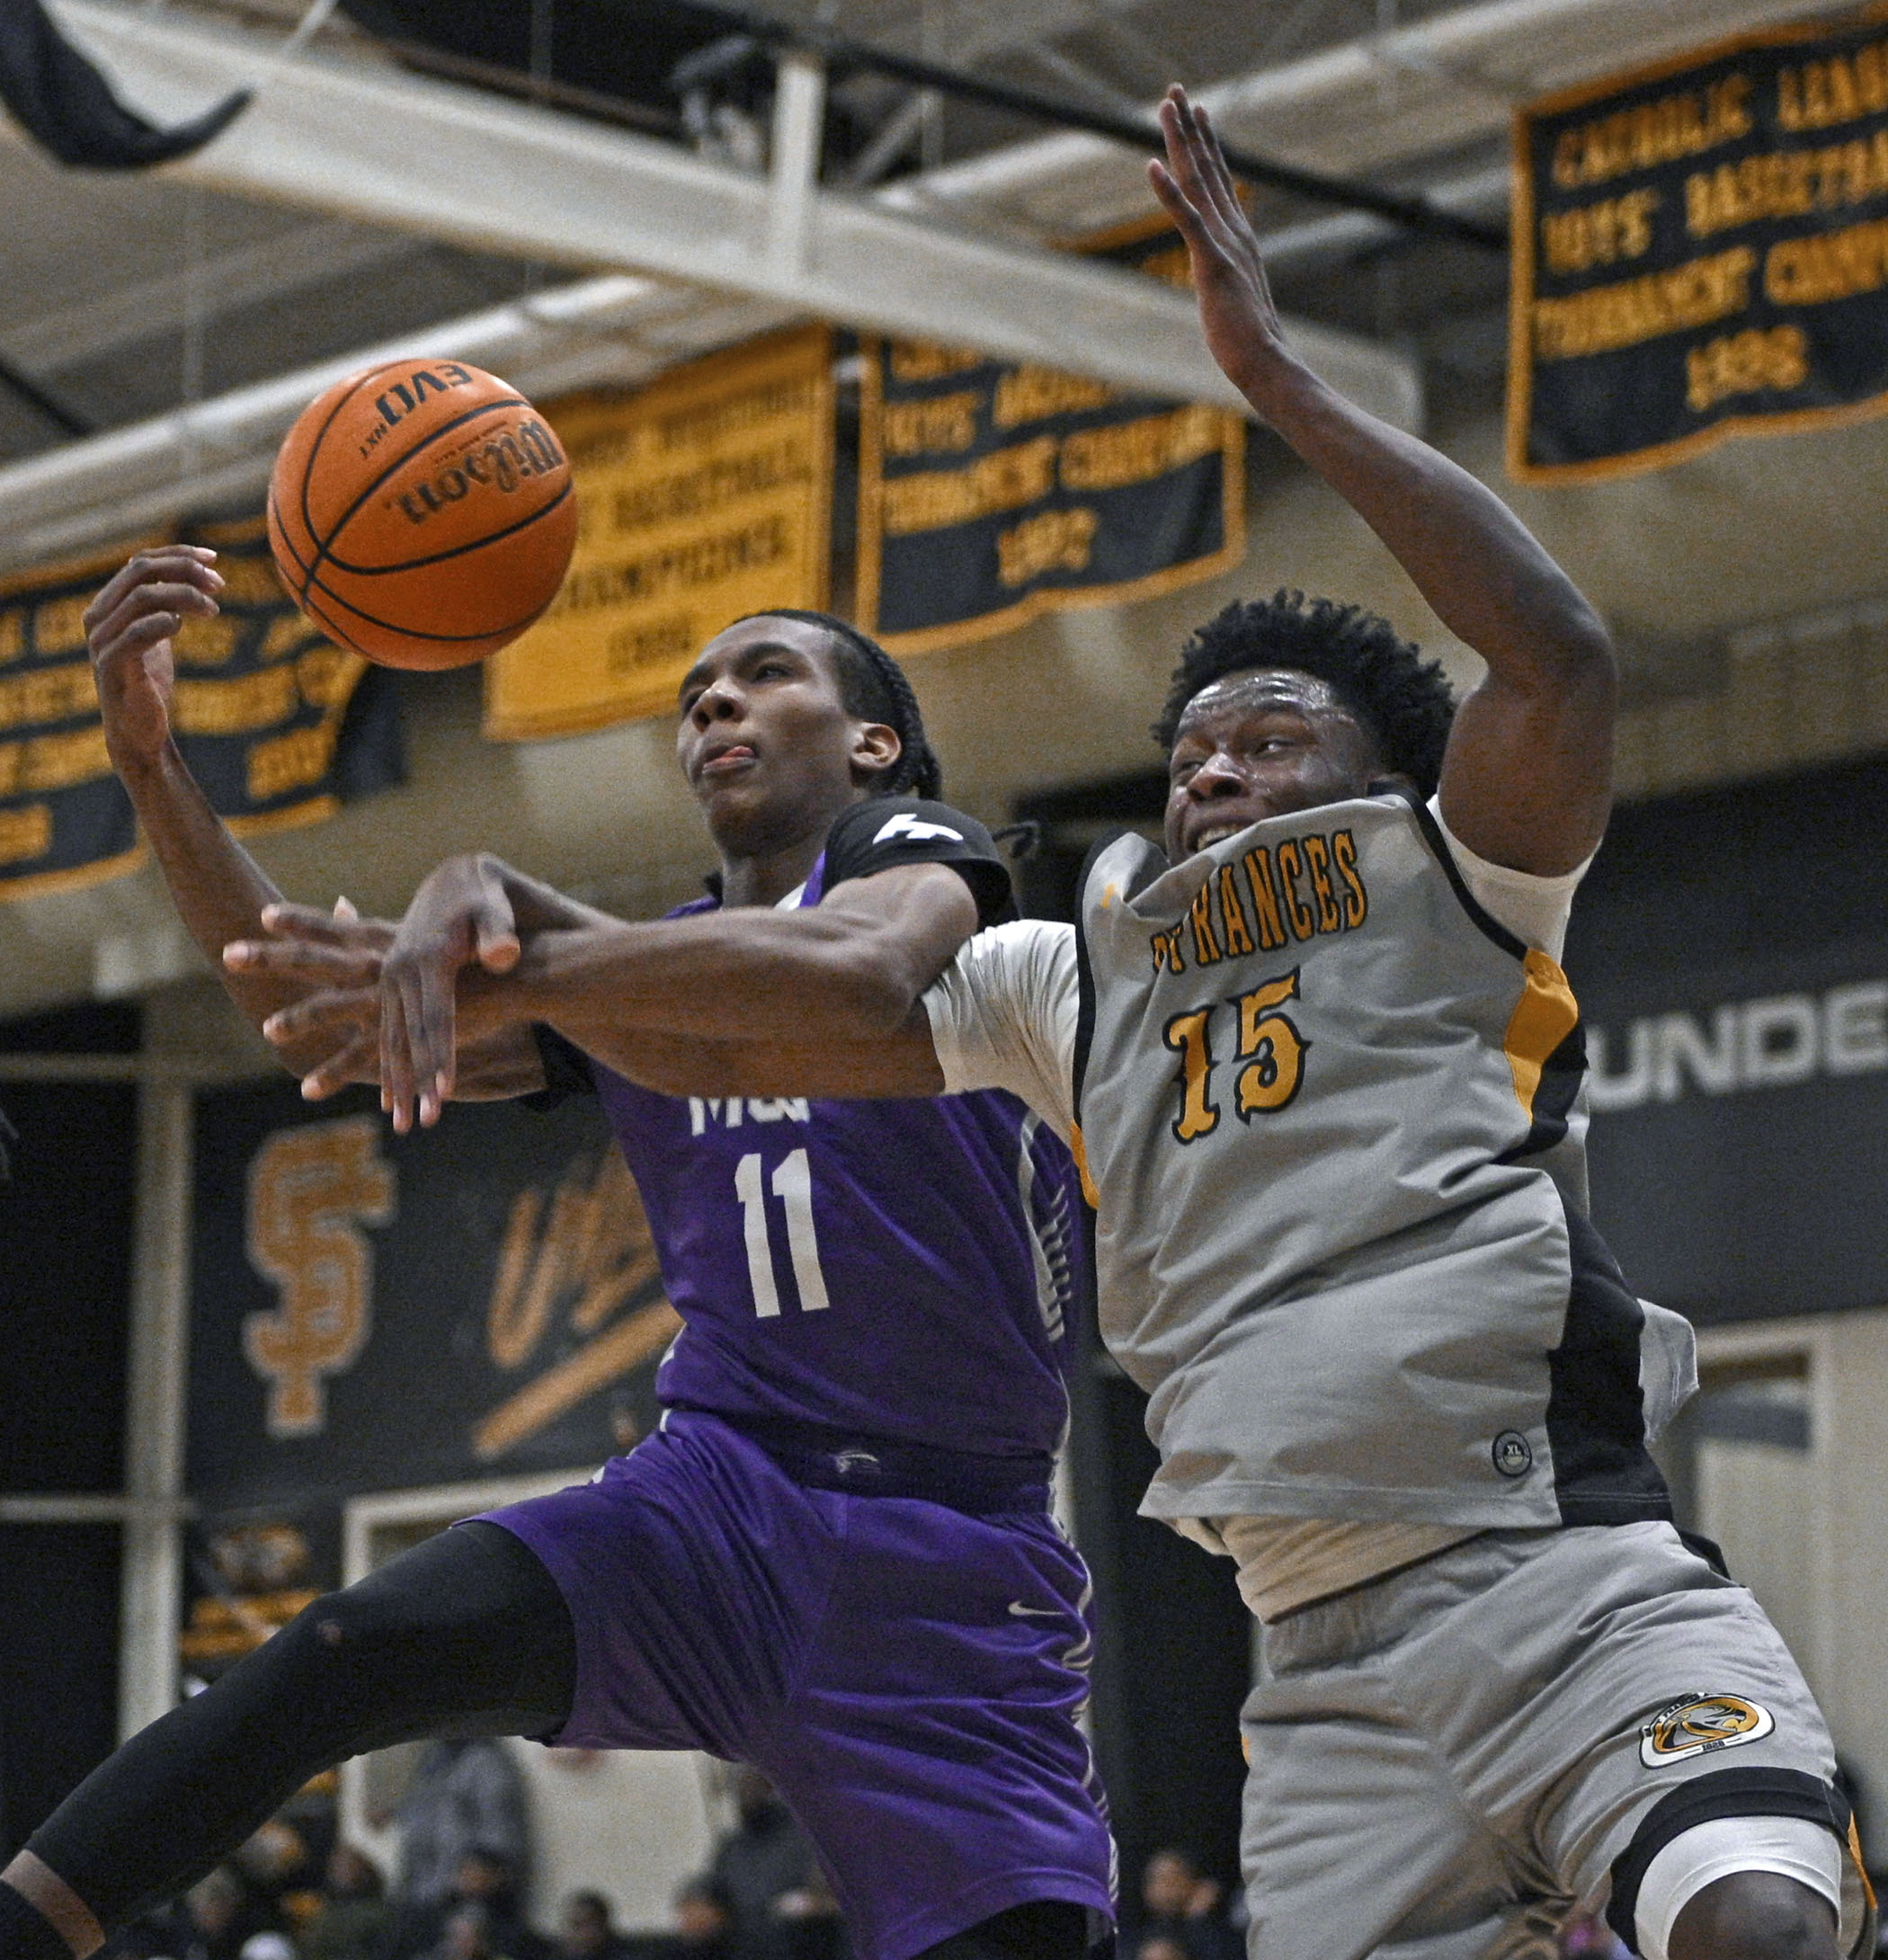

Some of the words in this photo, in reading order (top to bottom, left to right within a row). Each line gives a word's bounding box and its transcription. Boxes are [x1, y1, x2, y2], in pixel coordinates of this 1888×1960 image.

[376, 364, 472, 425] EVO
[359, 423, 387, 459] NXT
[397, 418, 564, 525] Wilson
[1162, 966, 1313, 1145] 15
[734, 1147, 830, 1318] 11
[1507, 1445, 1522, 1456] XL
